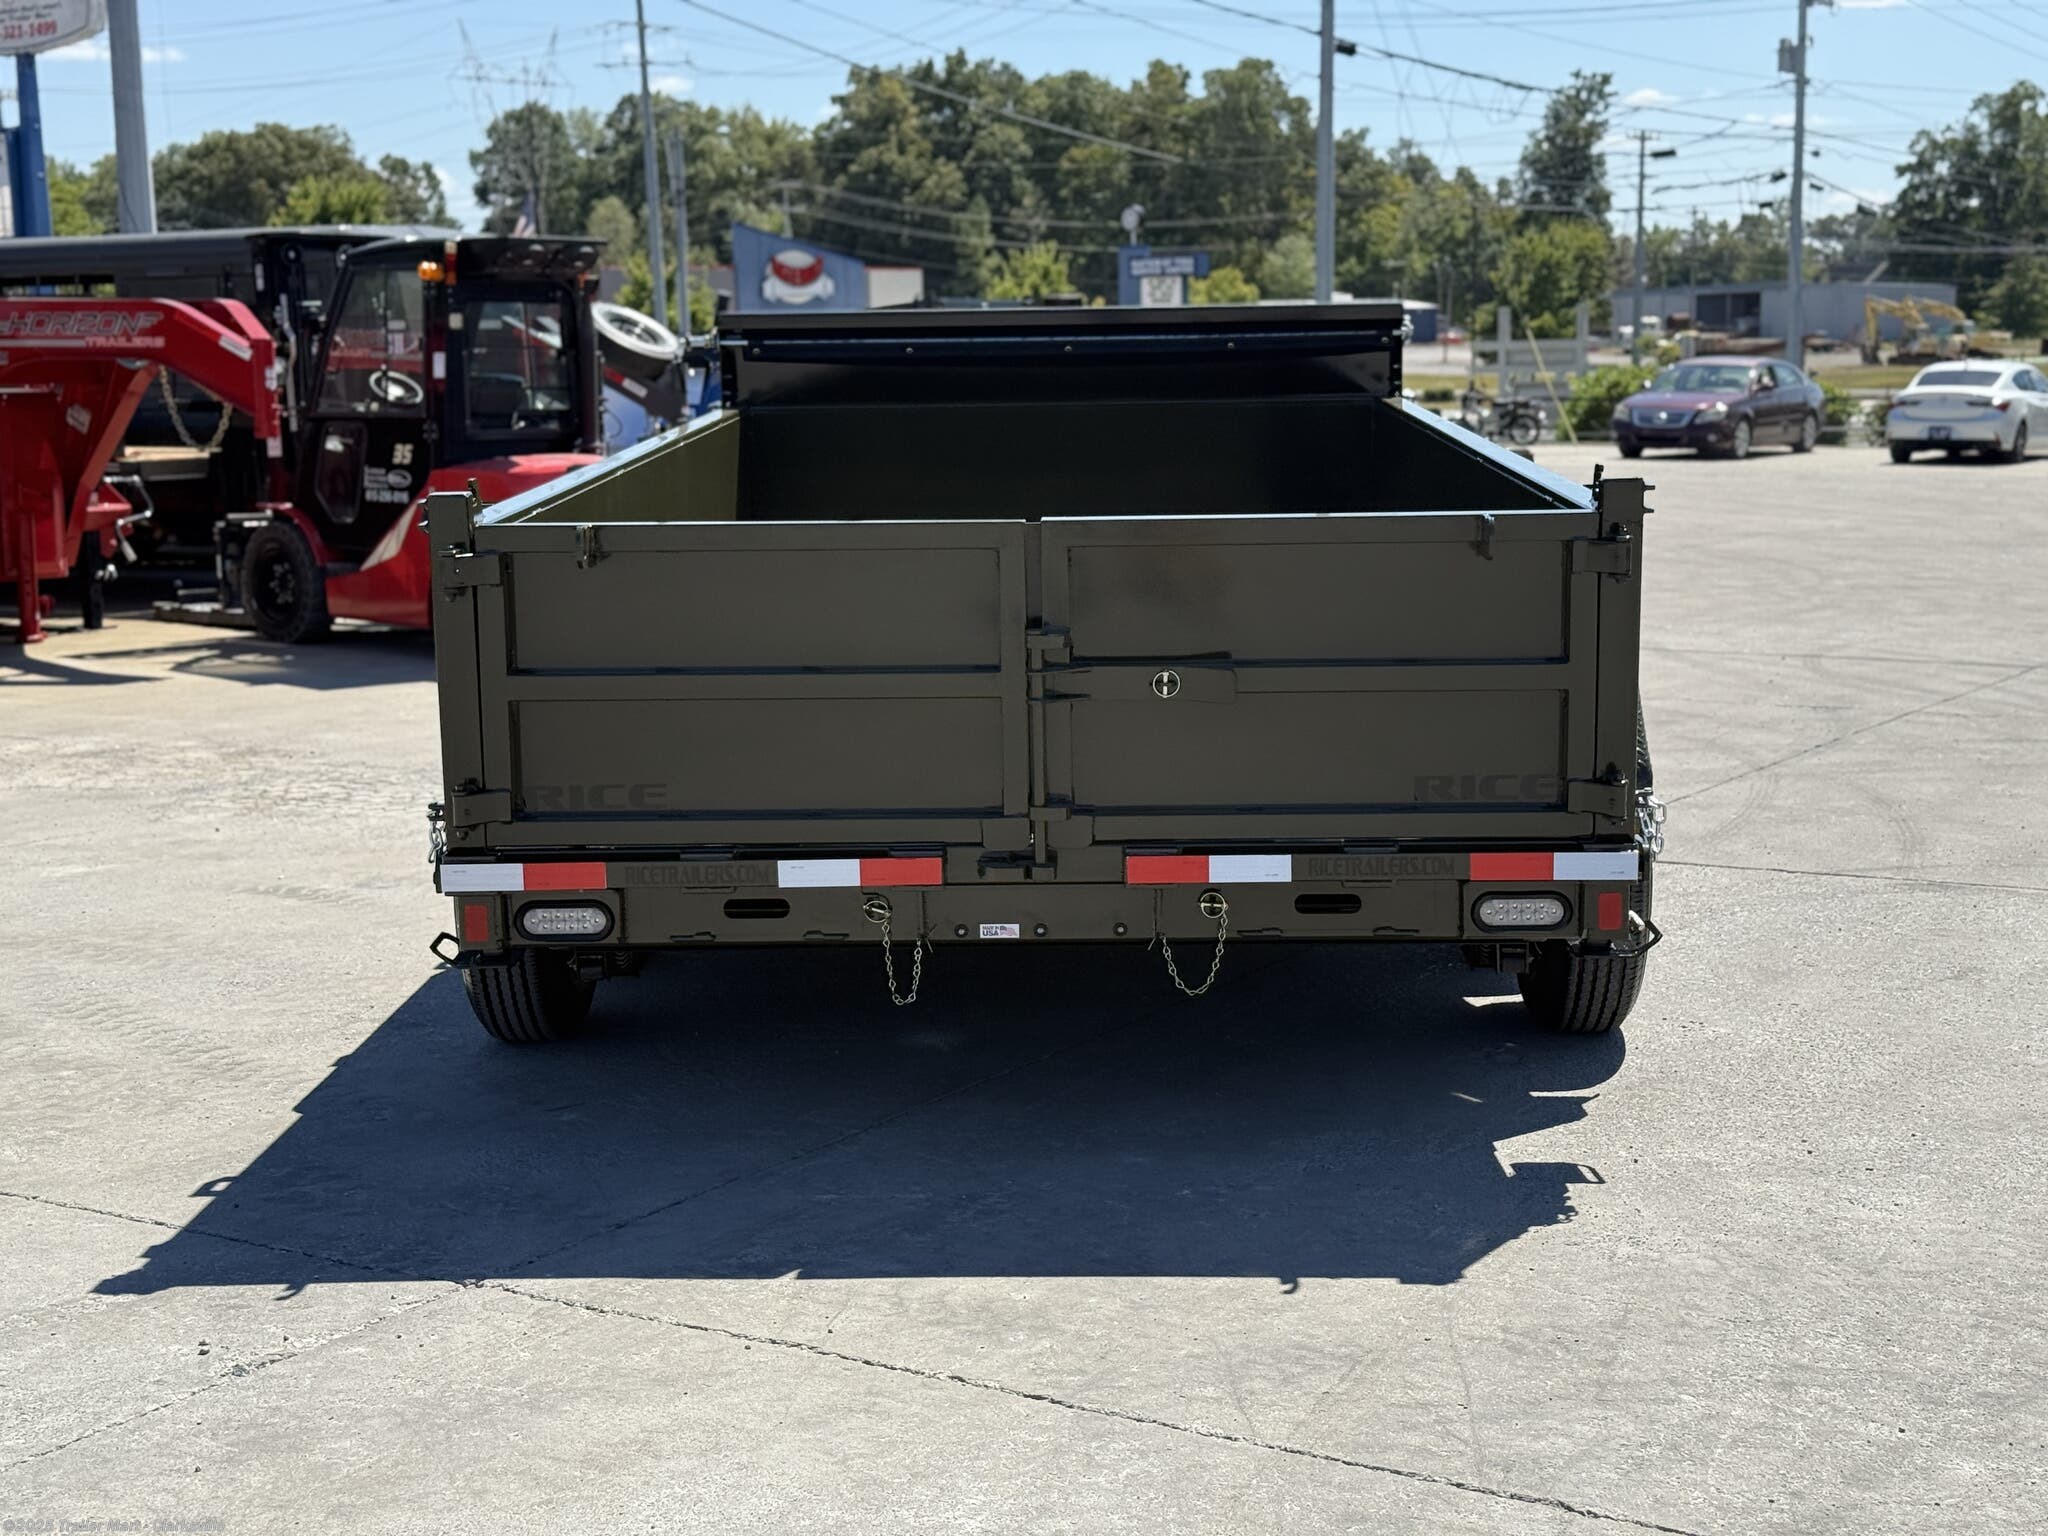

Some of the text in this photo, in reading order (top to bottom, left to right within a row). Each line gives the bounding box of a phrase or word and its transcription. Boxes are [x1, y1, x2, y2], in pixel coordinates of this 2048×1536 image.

[7, 311, 152, 335] HORIZON
[85, 336, 165, 347] TRAILERS
[392, 443, 414, 465] 35
[523, 783, 668, 810] RICE
[1413, 774, 1558, 800] RICE
[624, 864, 770, 885] RICETRAILERS.COM
[1306, 856, 1455, 876] RICETRAILERS.COM
